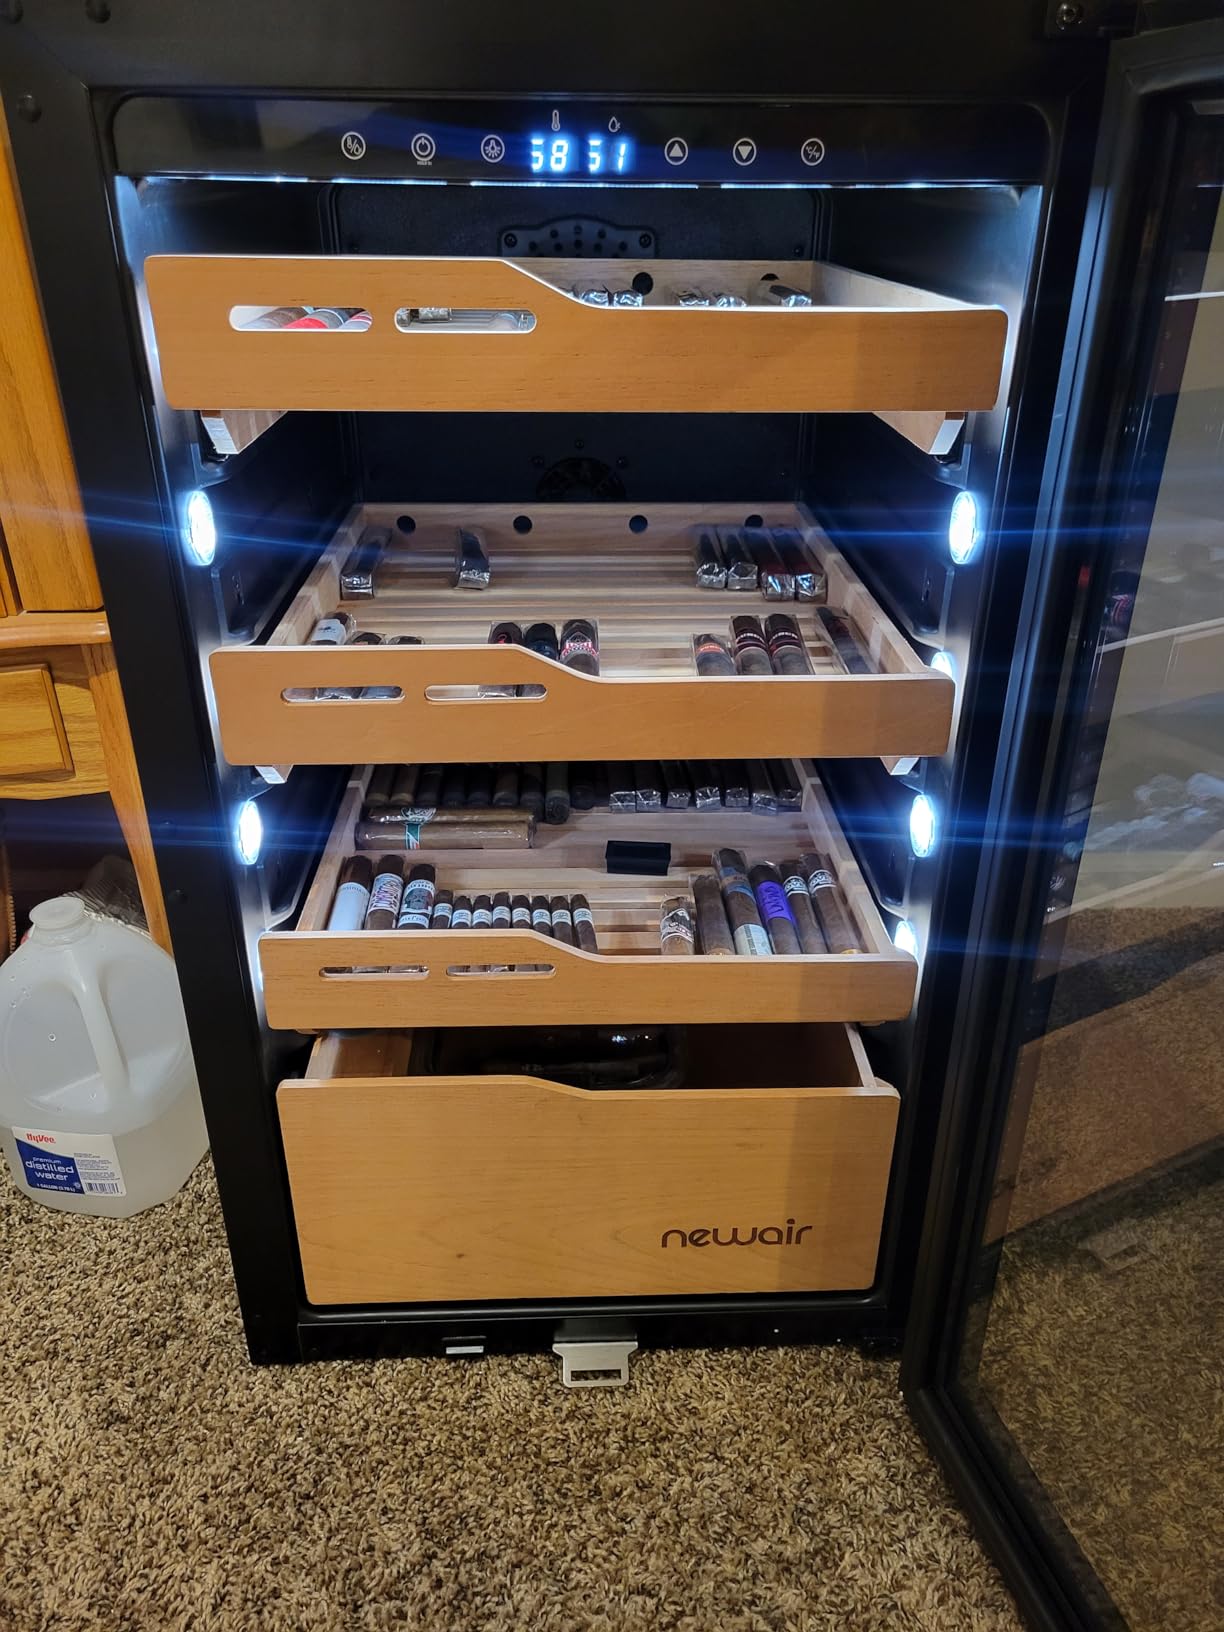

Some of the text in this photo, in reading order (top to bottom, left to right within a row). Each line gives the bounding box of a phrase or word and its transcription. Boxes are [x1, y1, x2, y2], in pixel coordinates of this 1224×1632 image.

[531, 138, 569, 173] 58
[588, 139, 627, 174] 51
[25, 1160, 75, 1174] distilled
[35, 1171, 69, 1181] water
[661, 1218, 813, 1248] newair
